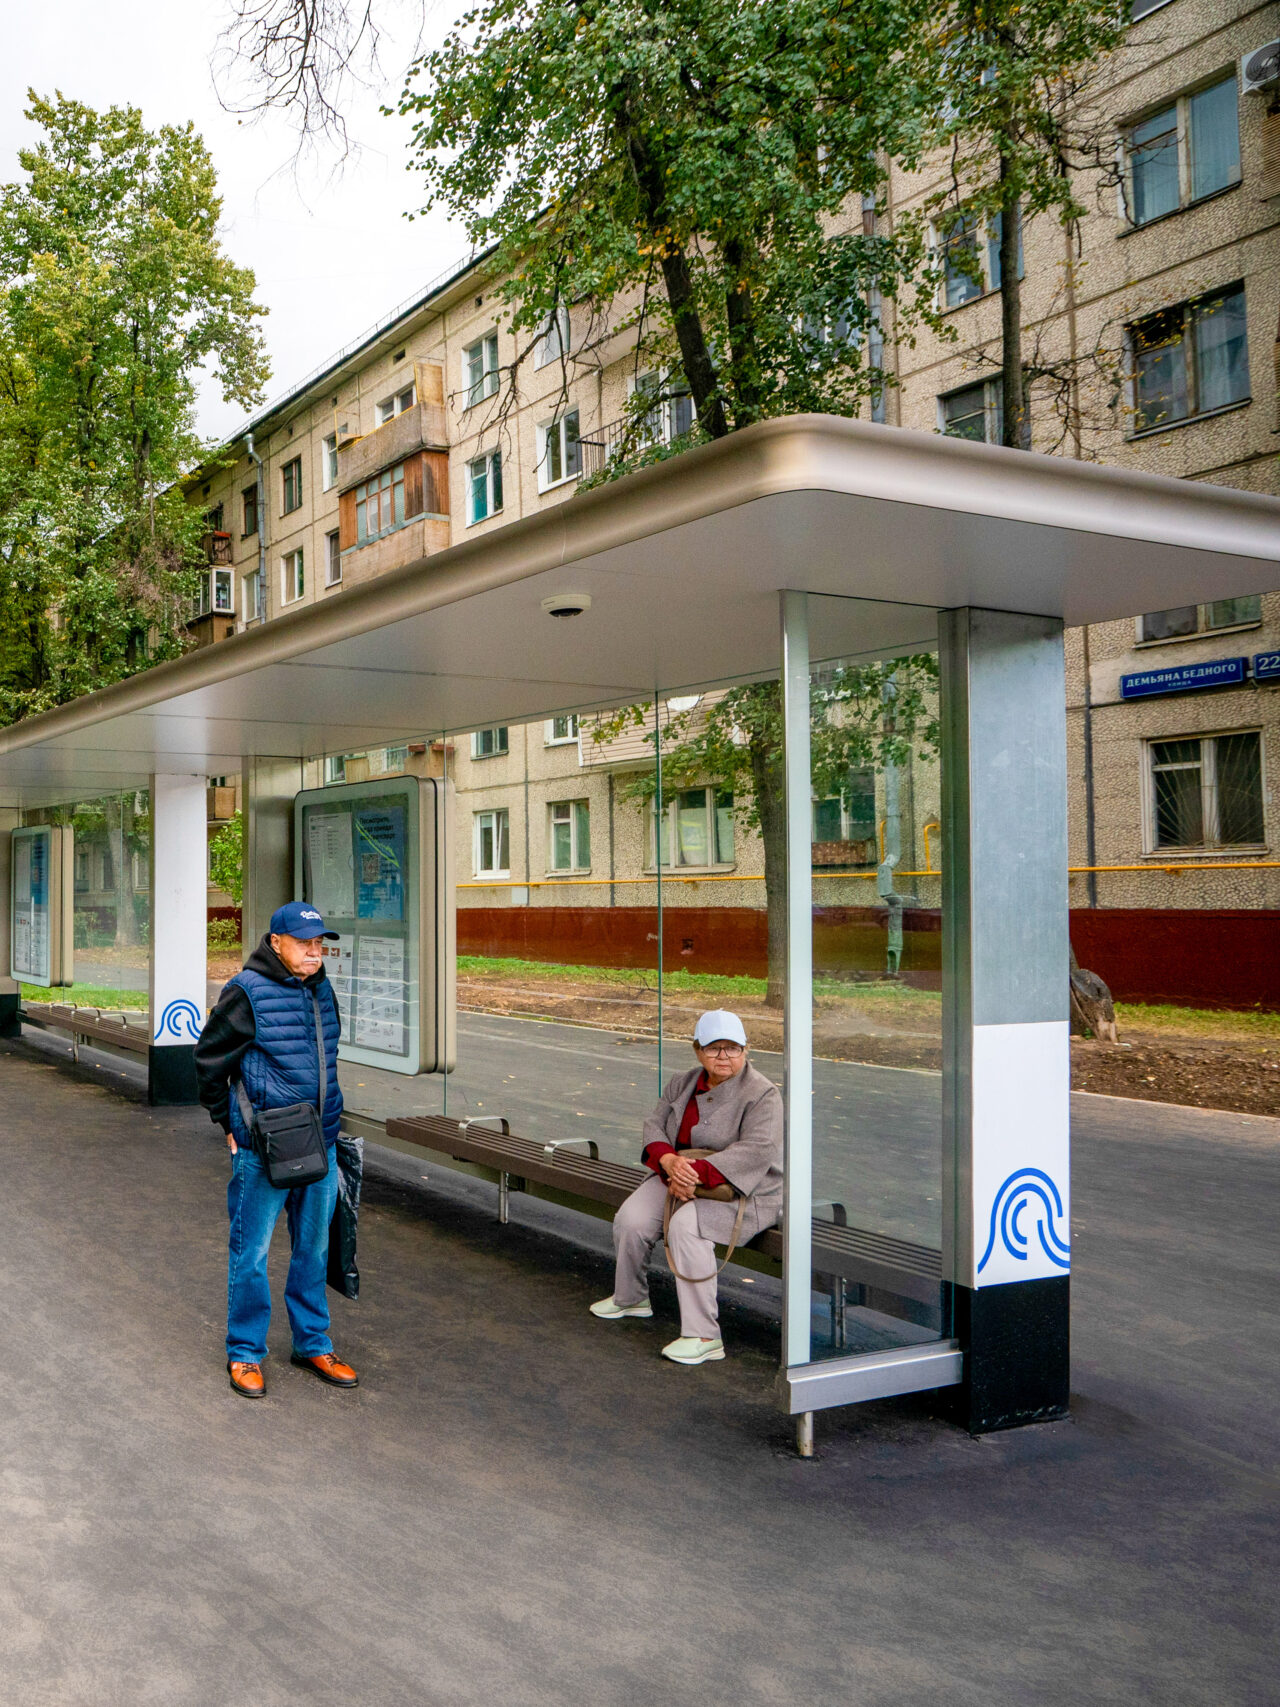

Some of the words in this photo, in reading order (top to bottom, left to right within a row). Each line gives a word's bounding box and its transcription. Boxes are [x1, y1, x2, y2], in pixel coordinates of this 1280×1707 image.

[1258, 655, 1280, 671] 22
[1126, 673, 1180, 687] ДЕМЬЯНА
[1183, 664, 1236, 678] БЕДНОГО
